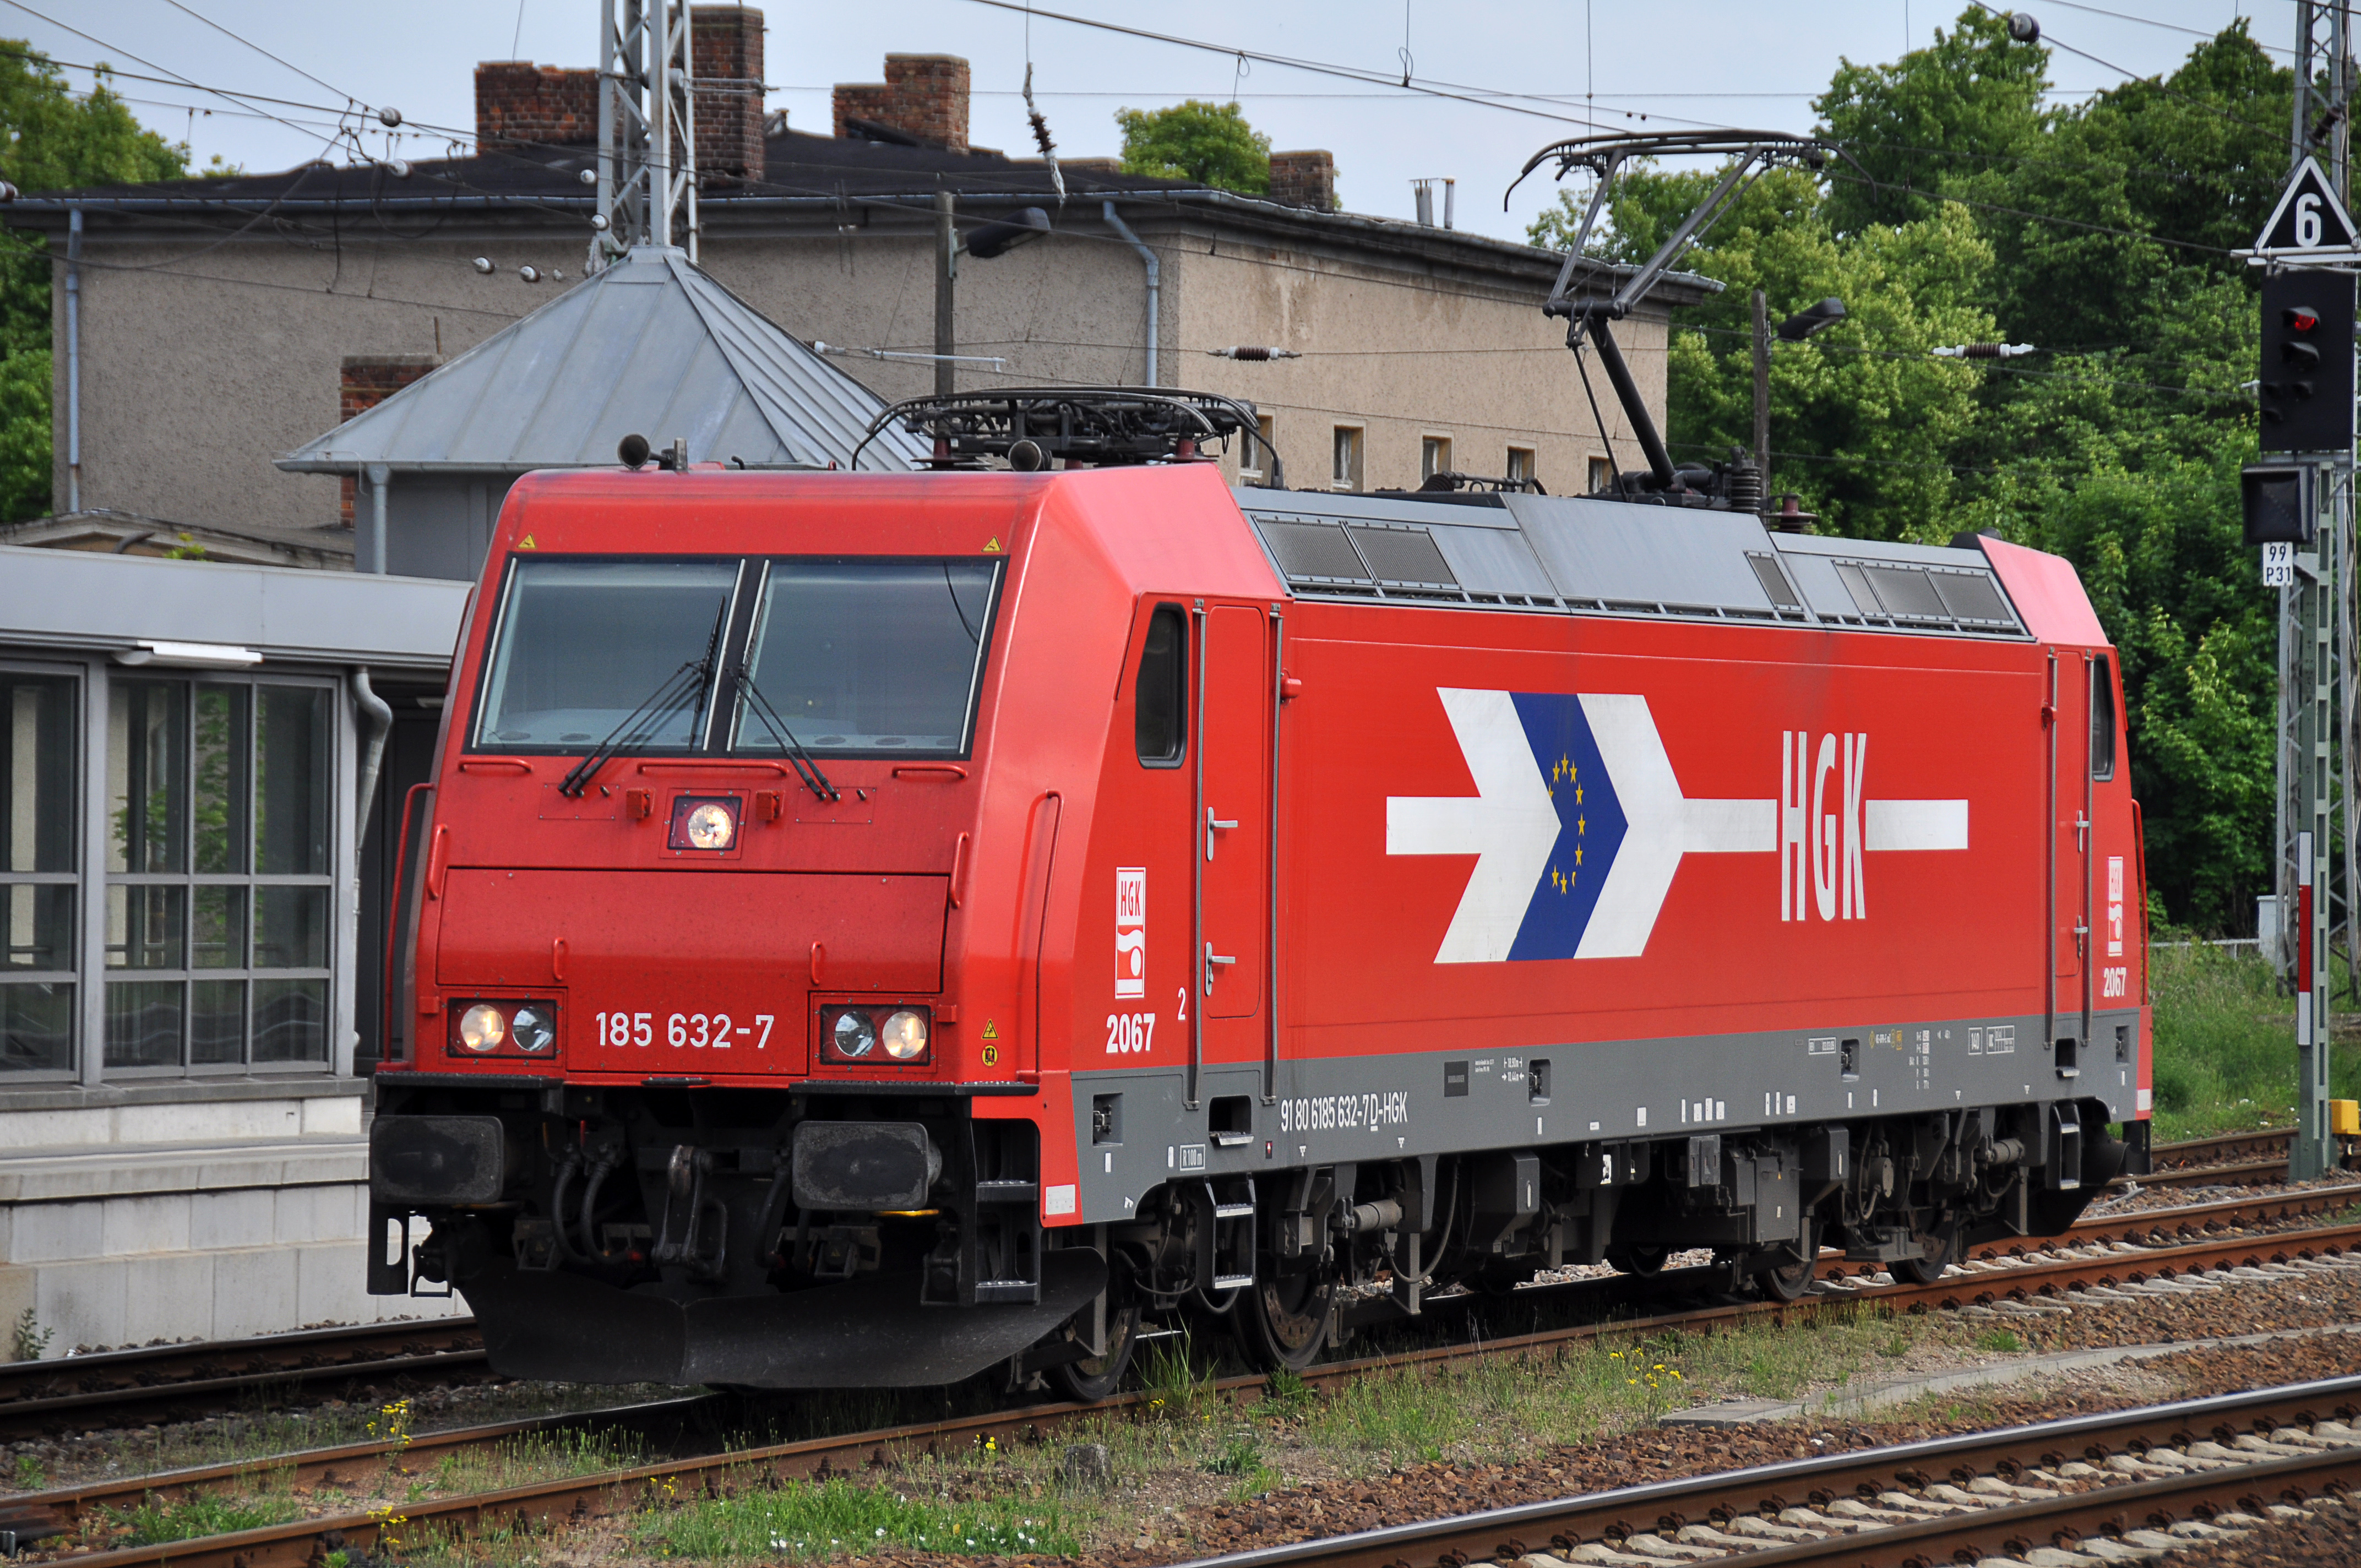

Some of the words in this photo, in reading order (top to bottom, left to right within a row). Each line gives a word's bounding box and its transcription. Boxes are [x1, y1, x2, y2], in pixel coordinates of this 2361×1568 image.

[2296, 193, 2321, 247] 6
[2270, 546, 2286, 561] 99
[2266, 567, 2290, 581] P31
[1781, 731, 1867, 921] HGK
[1120, 880, 1141, 916] HGK
[2103, 967, 2126, 997] 2067
[1178, 987, 1186, 1020] 2
[596, 1012, 652, 1046] 185
[668, 1013, 774, 1048] 632-7
[1106, 1013, 1155, 1053] 2067
[1281, 1099, 1293, 1131] 91
[1296, 1098, 1309, 1130] 80
[1312, 1096, 1335, 1129] 6185
[1183, 1150, 1187, 1166] R
